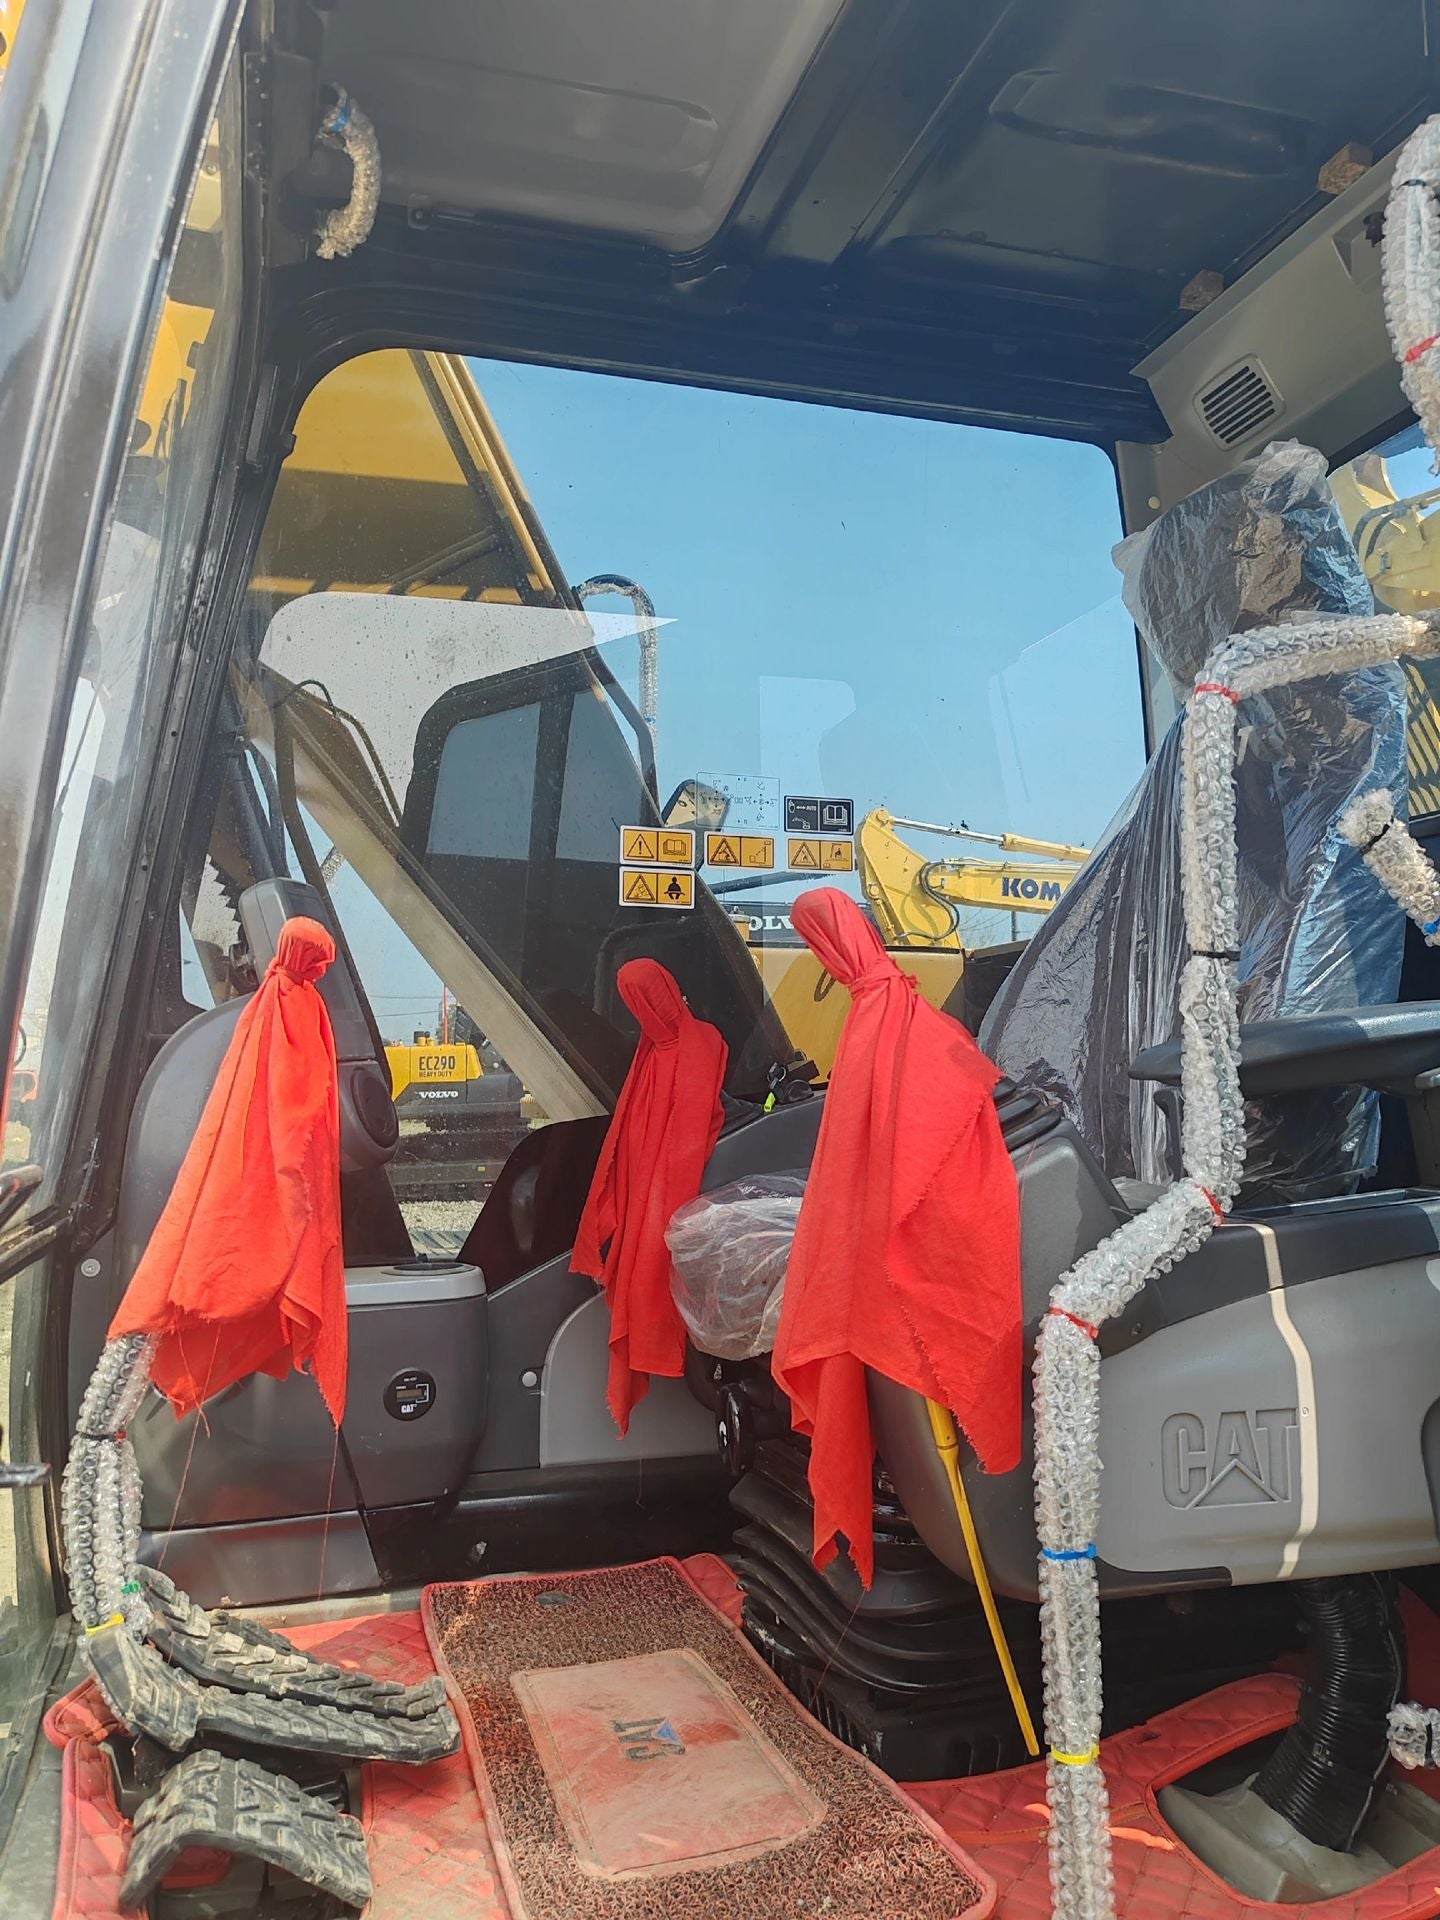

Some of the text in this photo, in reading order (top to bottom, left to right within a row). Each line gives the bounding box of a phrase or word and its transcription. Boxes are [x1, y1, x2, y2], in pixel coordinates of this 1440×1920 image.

[419, 1055, 456, 1071] EC290
[418, 1090, 459, 1099] VOLVO
[1161, 1408, 1299, 1510] CAT
